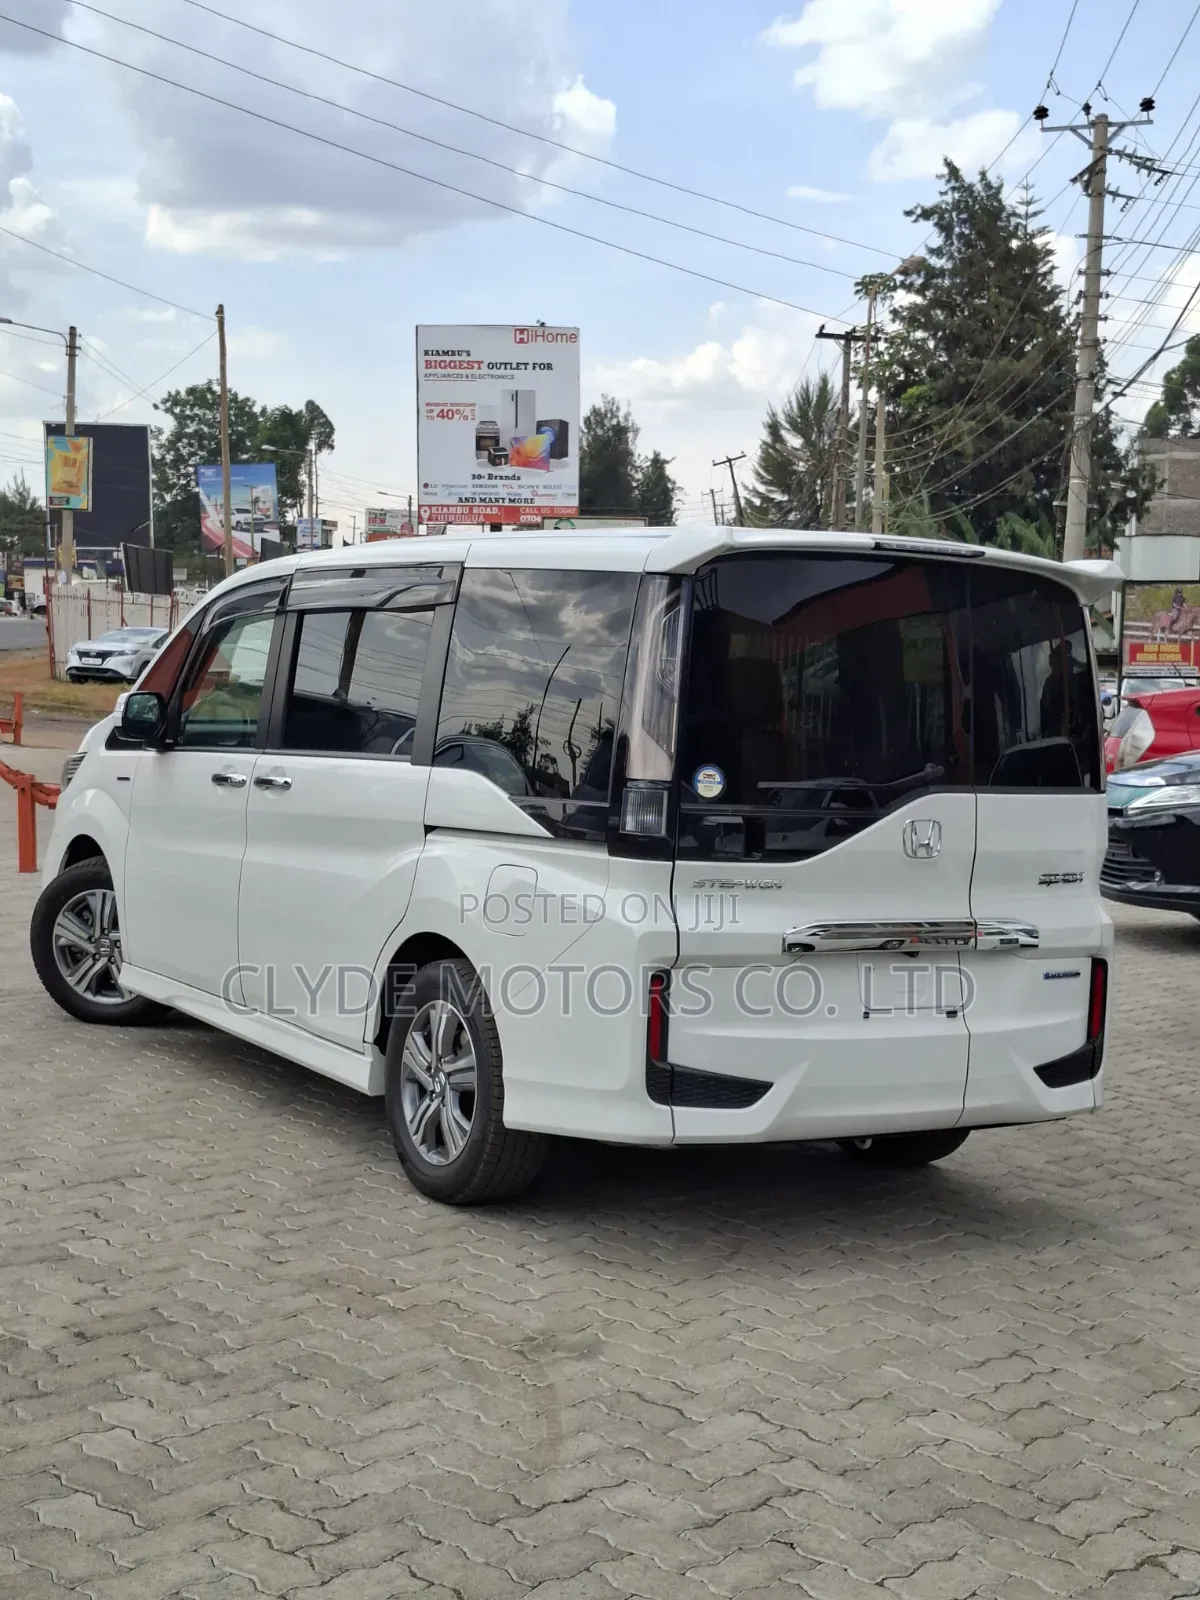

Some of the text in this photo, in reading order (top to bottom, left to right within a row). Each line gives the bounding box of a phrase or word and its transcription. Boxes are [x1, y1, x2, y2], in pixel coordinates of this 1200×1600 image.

[424, 349, 471, 357] KIAMBU'S
[424, 359, 554, 371] BIGGEST OUTLET FOR
[436, 408, 469, 421] 40%
[431, 506, 501, 515] KIAMBU ROAD,
[431, 514, 485, 522] THINDIGUA
